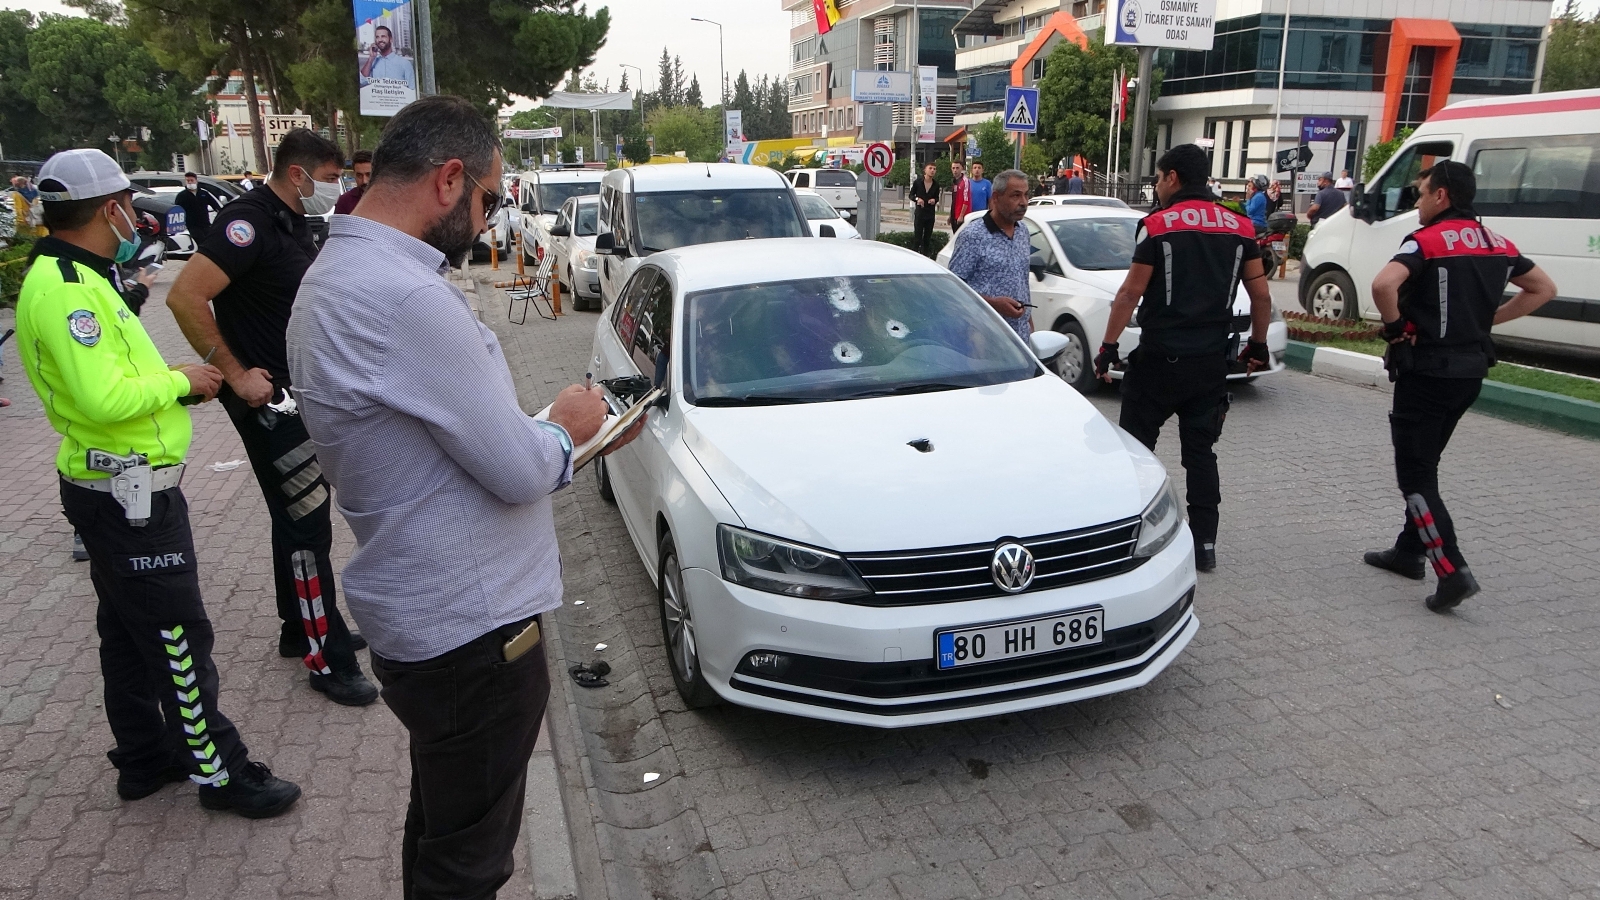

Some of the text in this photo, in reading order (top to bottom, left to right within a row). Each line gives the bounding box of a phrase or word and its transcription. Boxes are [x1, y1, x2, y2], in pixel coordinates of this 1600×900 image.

[1144, 11, 1212, 28] TİCARET VE SANAYİ
[1165, 29, 1188, 41] ODASI
[382, 78, 408, 86] Telekom
[168, 212, 185, 225] TAB
[1162, 206, 1240, 230] POLİS
[954, 615, 1098, 661] 80 HH 686
[941, 653, 954, 662] TR
